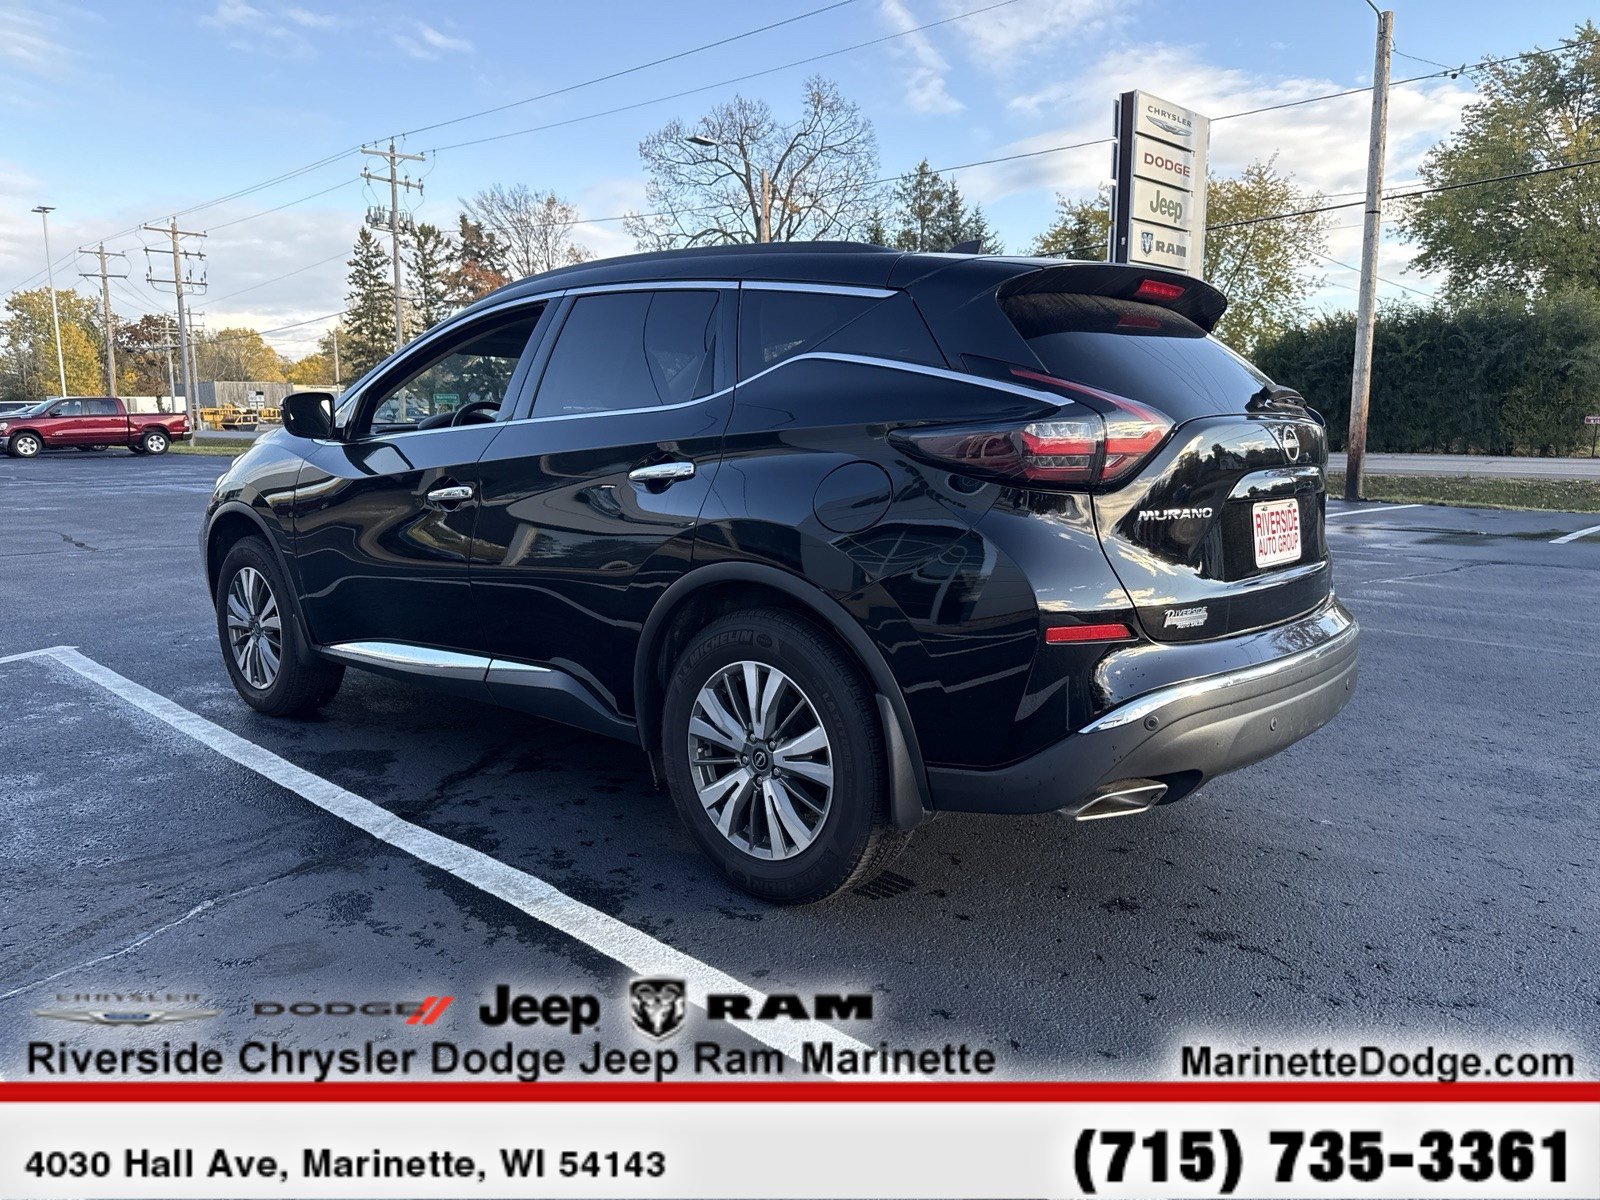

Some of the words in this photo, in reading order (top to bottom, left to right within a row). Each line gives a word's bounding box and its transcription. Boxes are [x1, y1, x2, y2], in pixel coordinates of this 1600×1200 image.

[1147, 105, 1192, 128] CHRYSLER
[1144, 152, 1191, 178] DODGE
[1149, 189, 1183, 224] Jeep
[1155, 240, 1187, 258] RAM
[1138, 507, 1213, 521] MURANO
[1255, 508, 1298, 537] RIVERSIDE
[1259, 536, 1277, 557] AUTO
[1278, 532, 1298, 553] GROUP
[689, 630, 754, 666] MICHELIN
